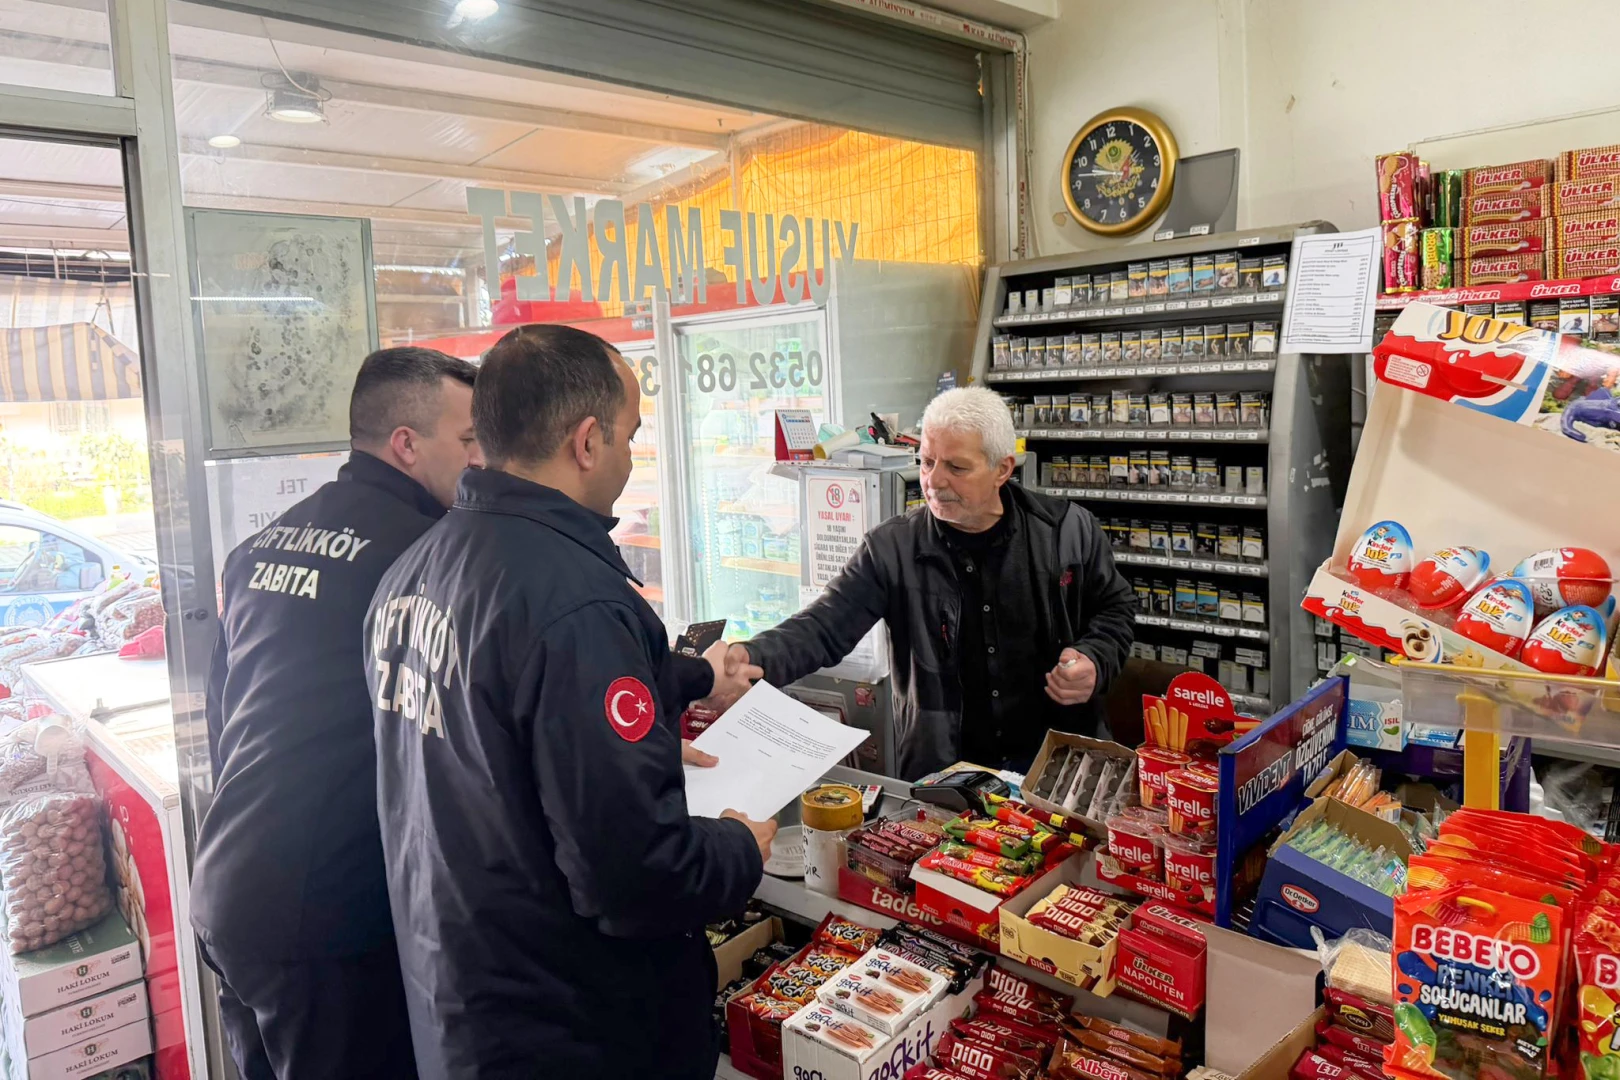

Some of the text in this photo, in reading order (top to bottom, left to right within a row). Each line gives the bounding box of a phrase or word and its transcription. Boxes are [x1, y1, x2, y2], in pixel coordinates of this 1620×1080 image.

[1106, 126, 1116, 138] 12
[1129, 125, 1134, 136] 1
[1090, 140, 1097, 151] 11
[1143, 136, 1151, 148] 2
[1078, 156, 1088, 167] 10
[1153, 155, 1160, 166] 3
[1579, 150, 1620, 168] ÜLKE
[1150, 178, 1157, 188] 4
[1475, 168, 1523, 186] ÜLKER
[1075, 181, 1082, 191] 9
[1560, 182, 1613, 199] ÜLKER
[1084, 199, 1091, 209] 8
[1138, 197, 1145, 208] 5
[1473, 197, 1522, 214] ÜLKER
[1101, 209, 1107, 220] 7
[1120, 208, 1127, 218] 6
[1564, 218, 1617, 235] ÜLKER
[1471, 228, 1520, 243] ÜLKER
[1565, 247, 1620, 264] ÜLKER
[1471, 258, 1520, 276] ÜLKER
[1530, 283, 1582, 298] ÜLKER
[818, 510, 834, 520] YASAL
[249, 521, 371, 562] ÇİFTLİKKÖY
[248, 561, 320, 600] ZABITA
[376, 659, 445, 739] ZABITA
[1174, 687, 1225, 708] sarelle
[1182, 771, 1216, 786] sarelle
[1136, 882, 1176, 902] sarelle
[1412, 926, 1538, 979] BEBETO
[866, 957, 902, 976] gofkit
[1133, 956, 1175, 986] ÜLKER
[57, 981, 78, 994] HAKİ
[80, 971, 110, 987] LOKUM
[836, 977, 873, 996] gofkit
[1420, 985, 1527, 1025] SOLUCANLAR
[61, 1013, 114, 1036] HAKİ LOKUM
[805, 1010, 843, 1031] gofkit
[1438, 1013, 1506, 1037] YUMUŞAK ŞEKER
[65, 1049, 119, 1073] HAKİ LOKUM
